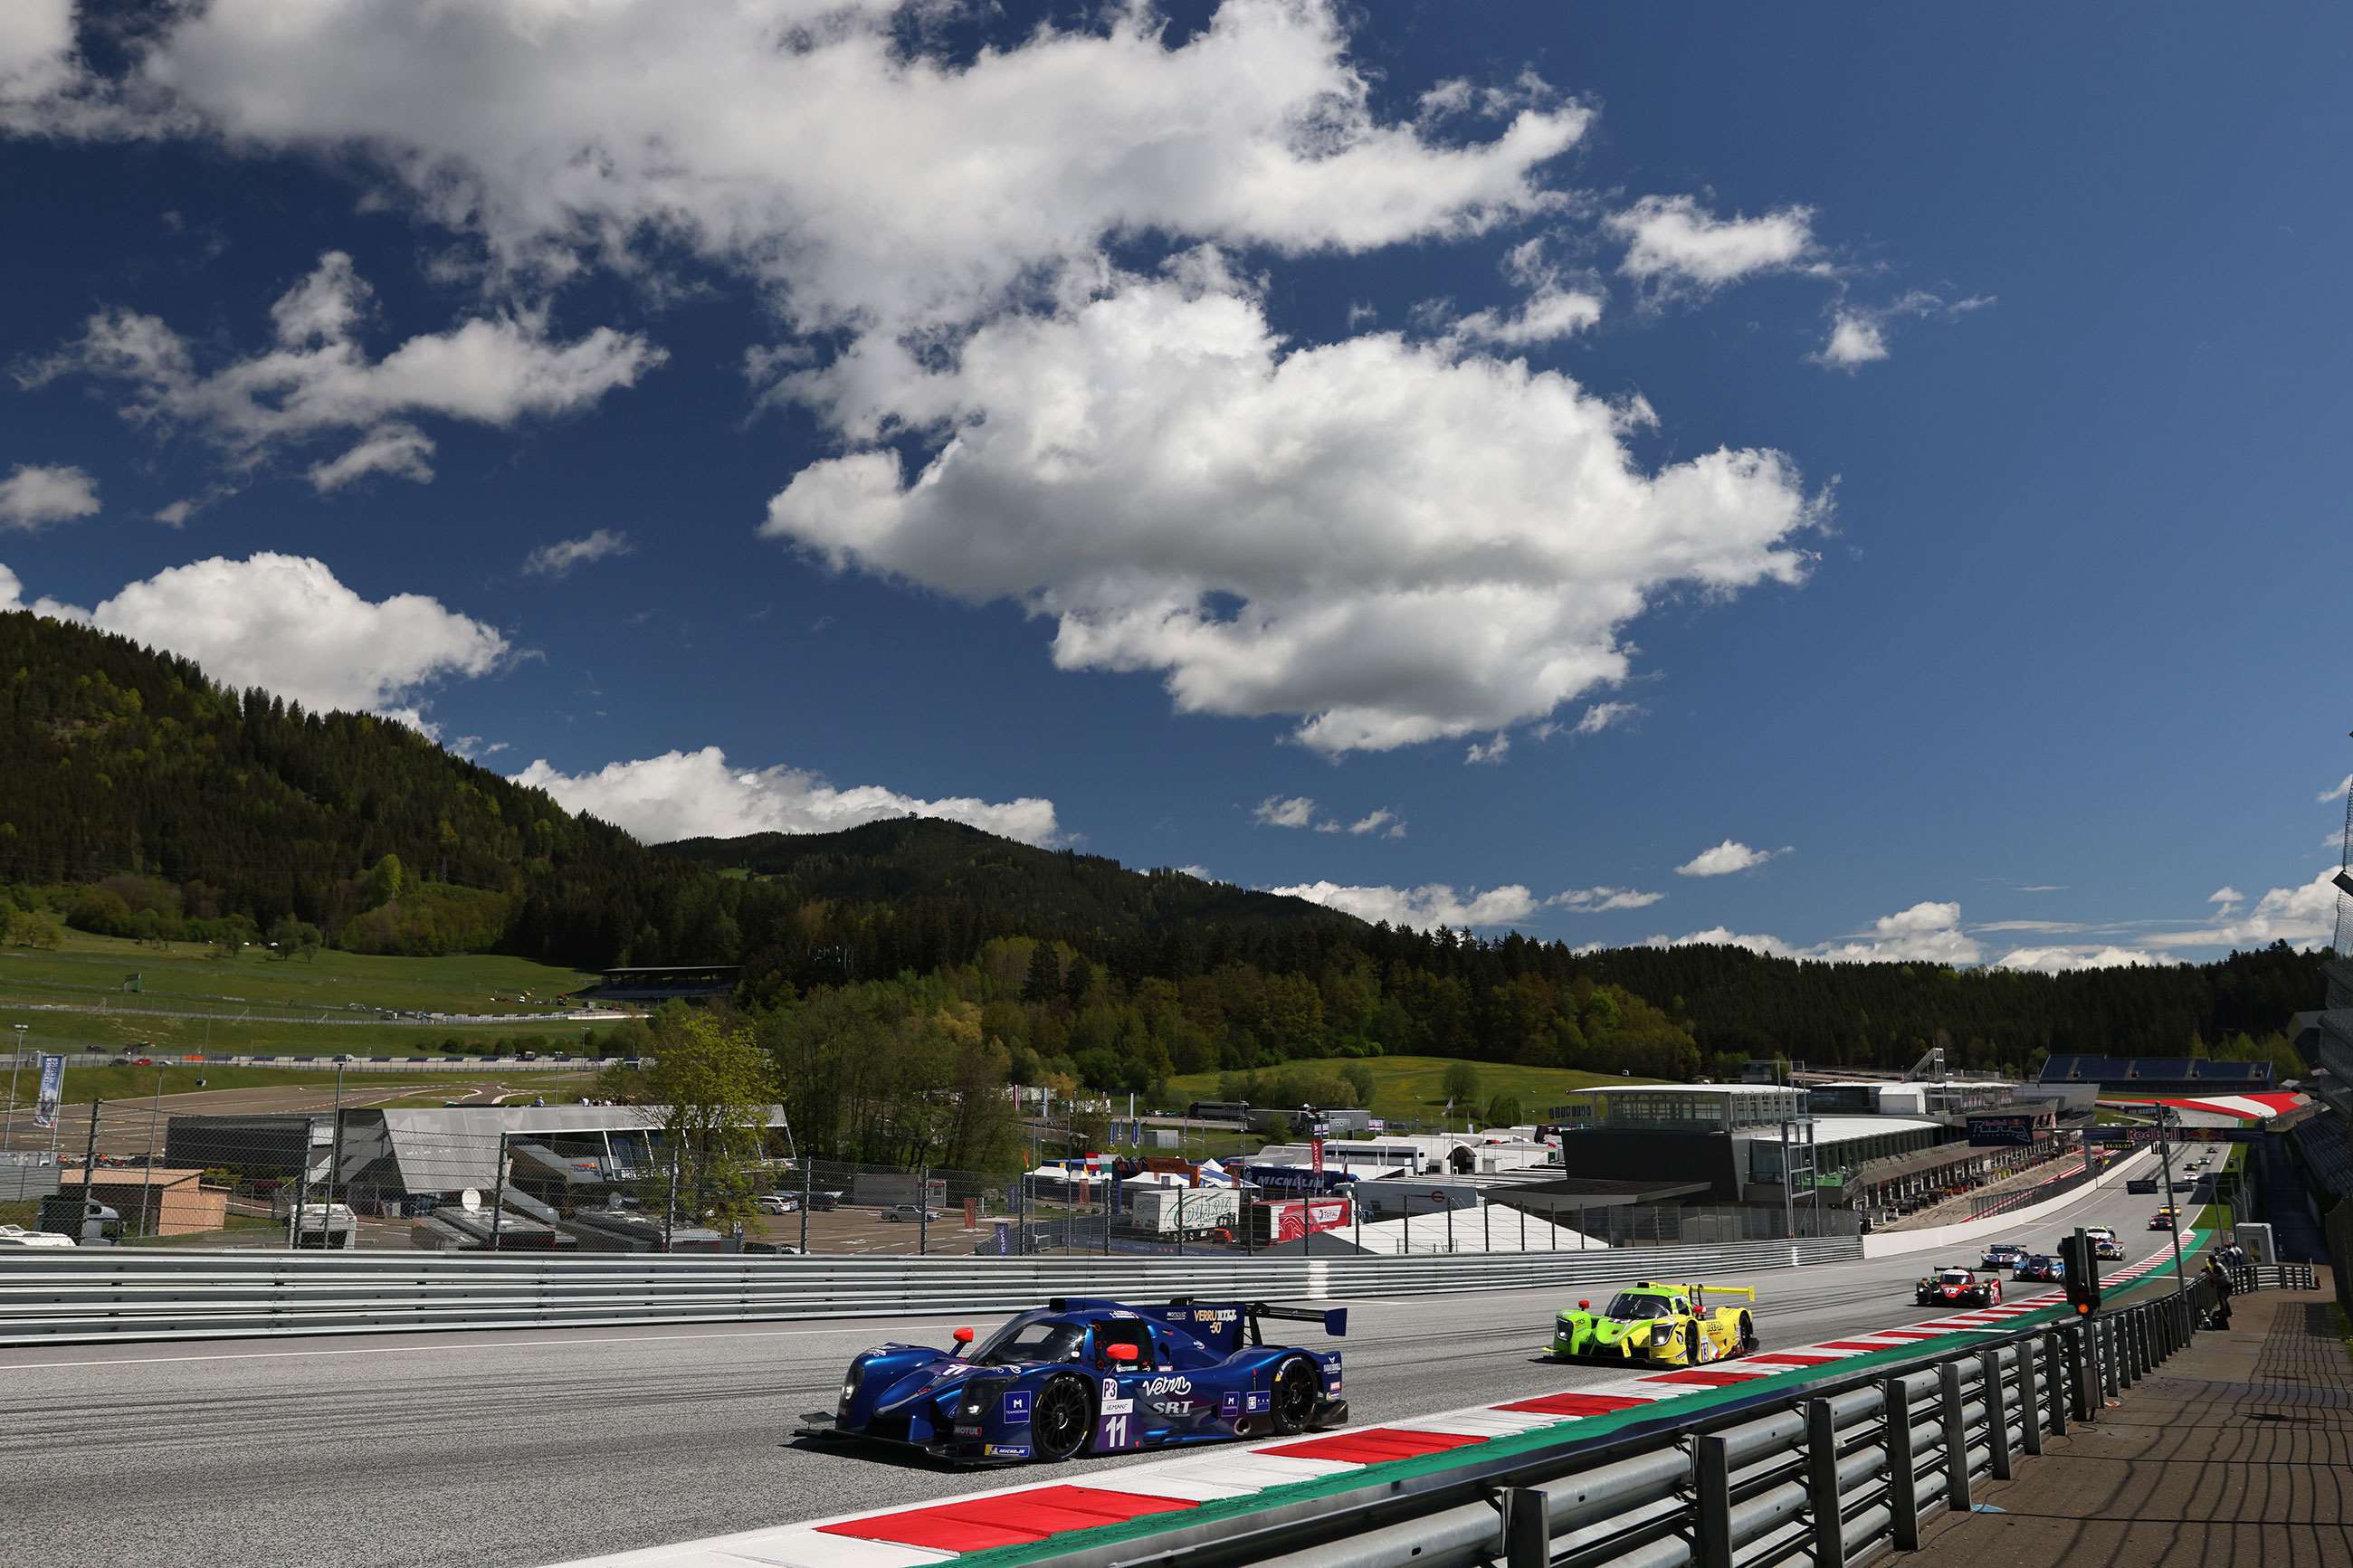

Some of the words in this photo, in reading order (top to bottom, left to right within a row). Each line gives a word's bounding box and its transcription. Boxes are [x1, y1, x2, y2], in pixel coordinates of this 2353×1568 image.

[2129, 1128, 2153, 1142] Red
[1257, 1175, 1325, 1188] MICHELIN
[1103, 1381, 1116, 1398] P3
[1014, 1399, 1023, 1409] M
[1153, 1401, 1194, 1414] SRT
[1106, 1415, 1127, 1448] 11
